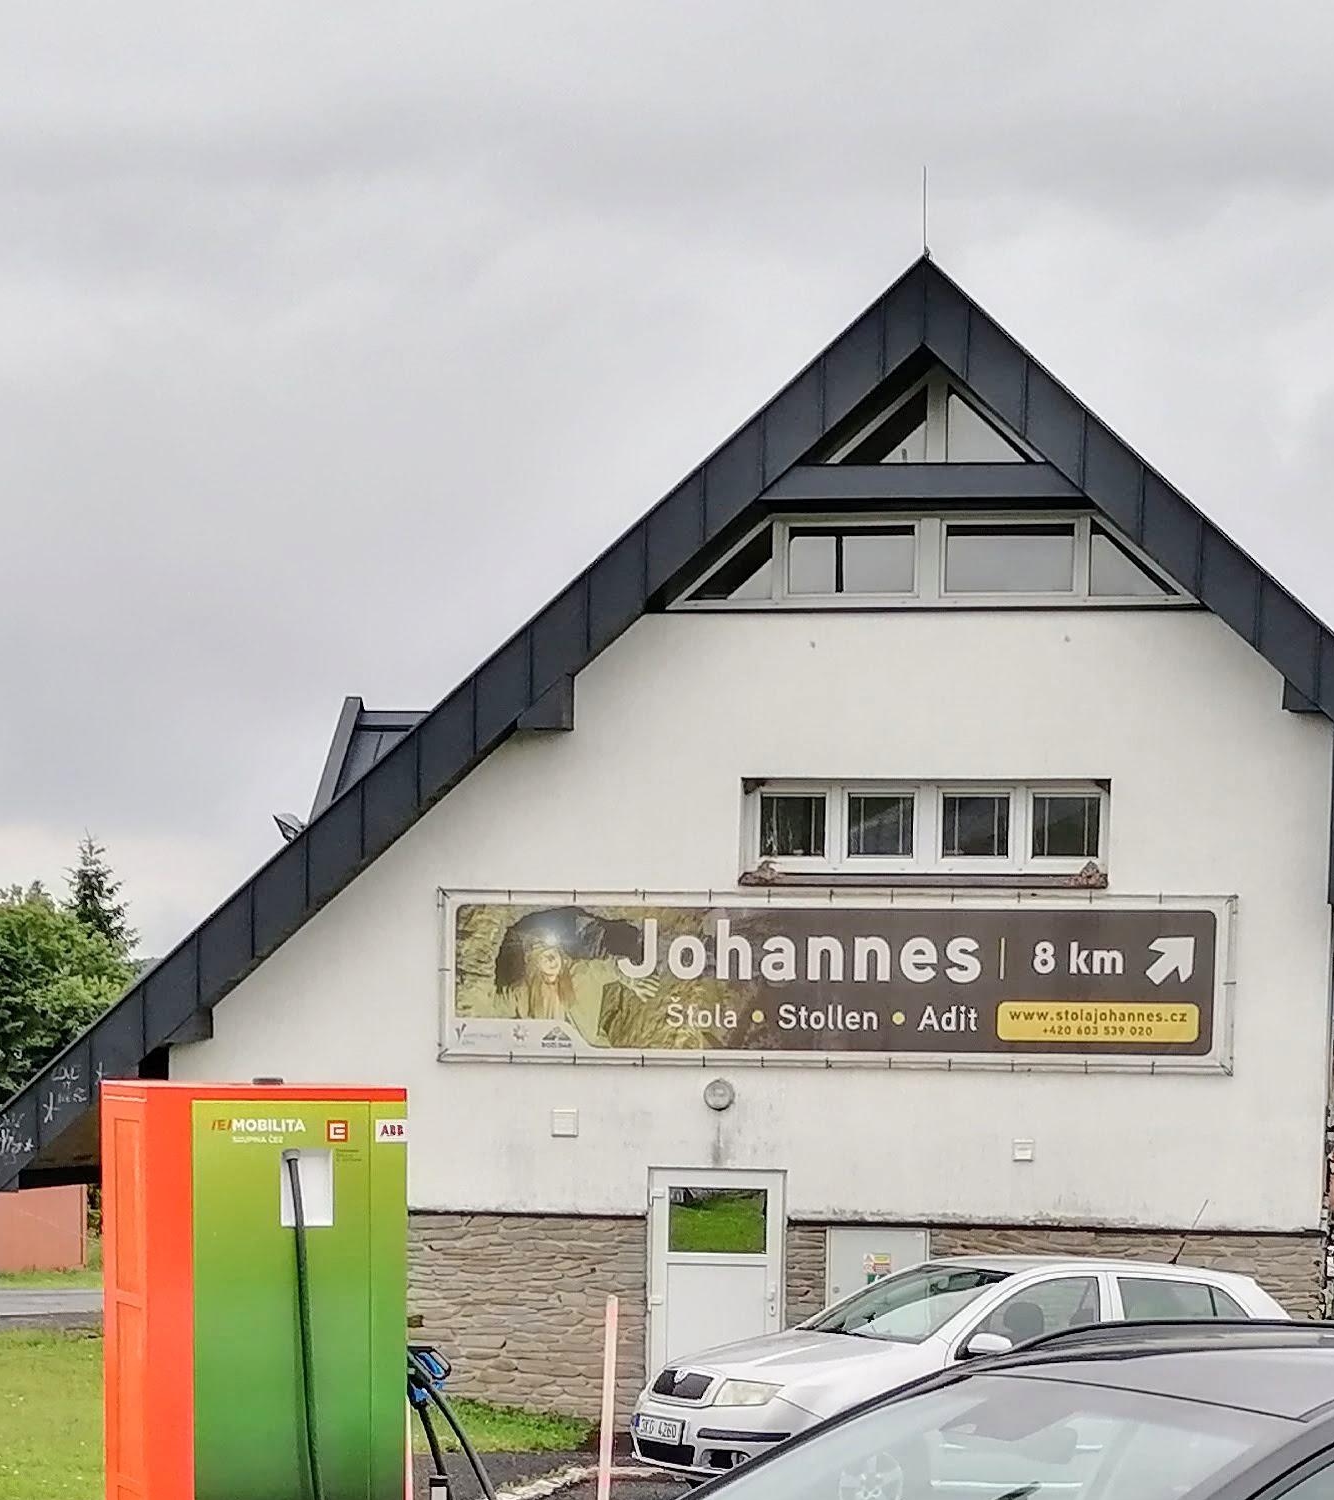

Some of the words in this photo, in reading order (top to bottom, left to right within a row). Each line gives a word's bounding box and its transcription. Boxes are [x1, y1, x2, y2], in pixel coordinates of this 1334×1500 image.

[617, 918, 982, 984] Johannes
[1032, 940, 1056, 975] 8
[1068, 940, 1124, 975] km
[665, 997, 738, 1030] Štola
[777, 1003, 879, 1031] Stollen
[917, 1003, 979, 1032] Adit
[1008, 1009, 1188, 1025] www.stolajohannes.cz
[1042, 1025, 1071, 1036] +420
[1076, 1025, 1099, 1036] 603
[1129, 1026, 1153, 1036] 020
[380, 1124, 405, 1137] ABB
